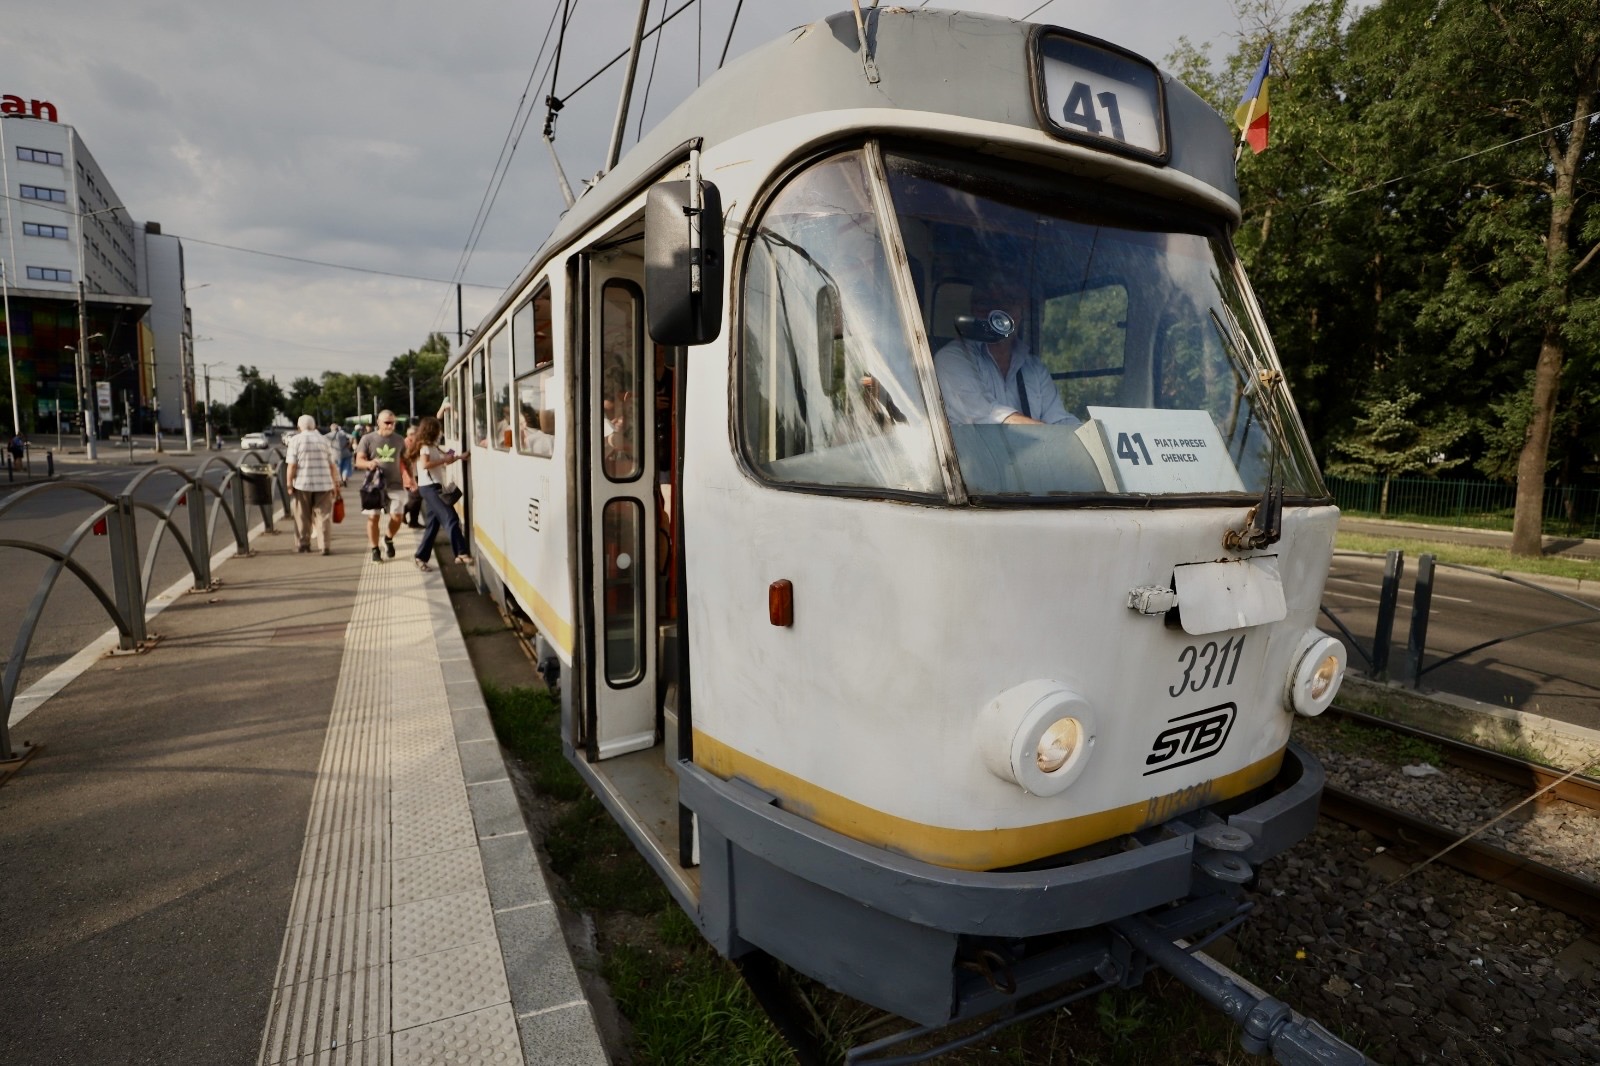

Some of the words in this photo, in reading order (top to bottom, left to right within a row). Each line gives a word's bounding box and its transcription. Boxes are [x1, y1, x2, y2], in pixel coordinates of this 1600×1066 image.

[1063, 81, 1125, 141] 41
[1117, 432, 1153, 465] 41
[1161, 453, 1199, 462] GHENCEA
[1180, 439, 1207, 448] PRESEI
[1169, 634, 1246, 698] 3311
[1145, 713, 1229, 765] STB
